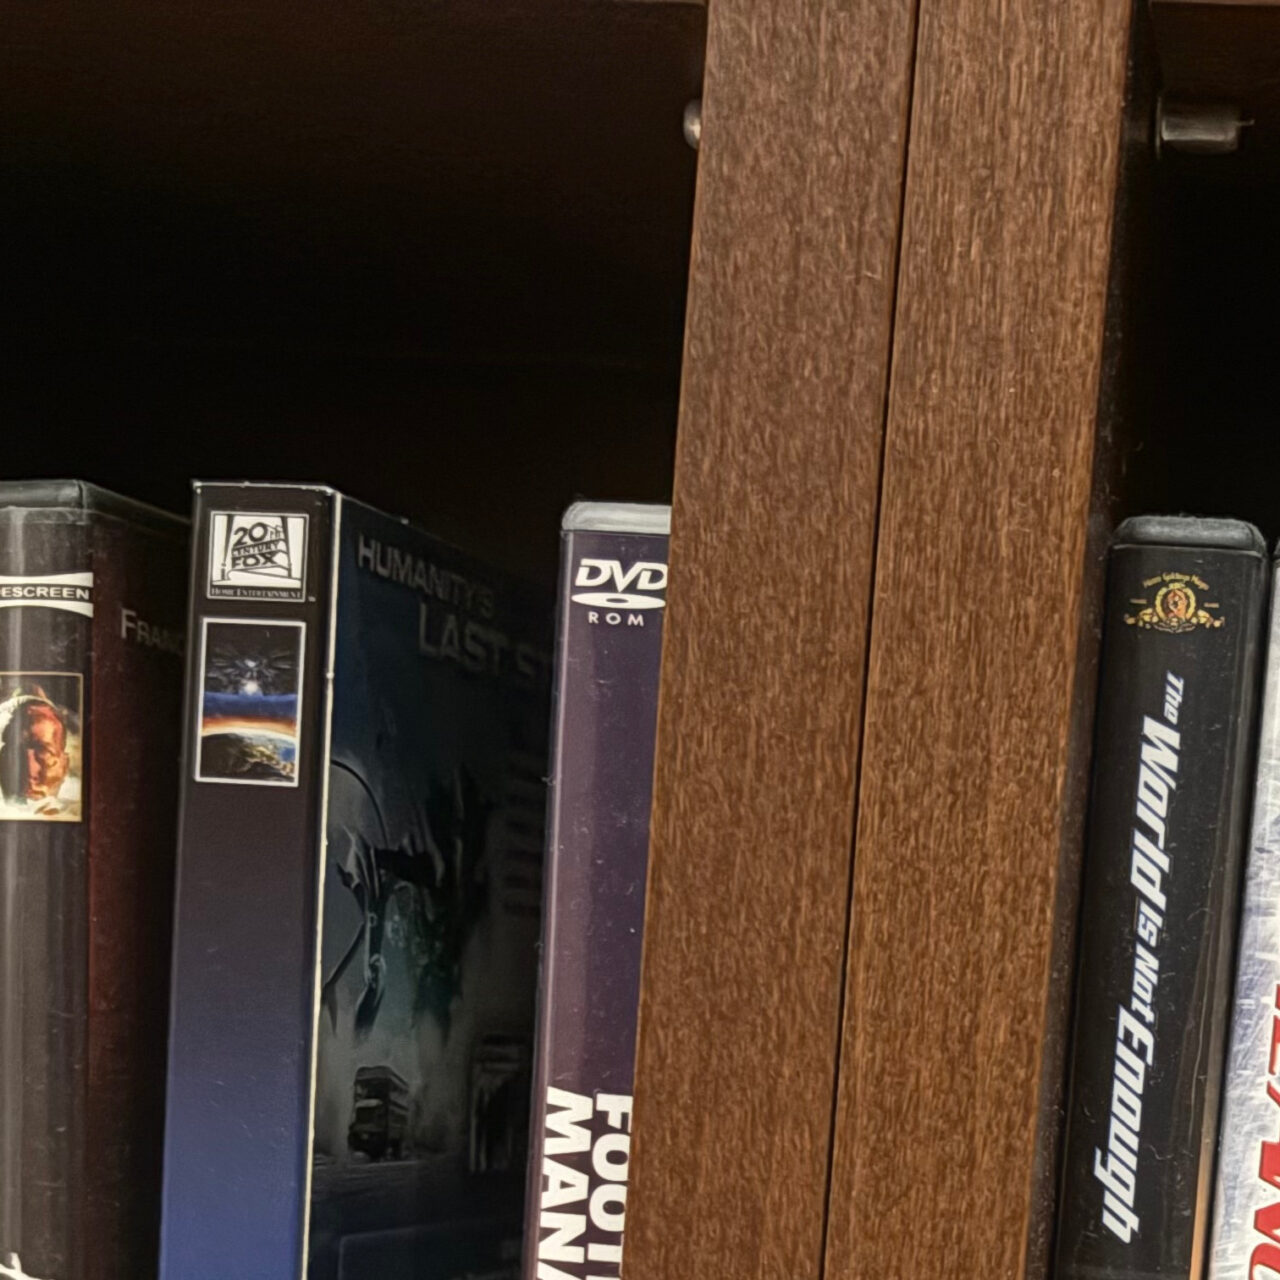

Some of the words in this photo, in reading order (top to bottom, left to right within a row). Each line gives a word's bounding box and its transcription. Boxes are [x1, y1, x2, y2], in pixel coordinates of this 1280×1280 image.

[231, 552, 278, 569] FOX
[575, 558, 668, 593] DVD
[588, 611, 644, 627] ROM
[1164, 670, 1184, 724] The
[1130, 715, 1181, 912] World
[1130, 944, 1160, 1023] Not
[1094, 1003, 1154, 1243] Enough
